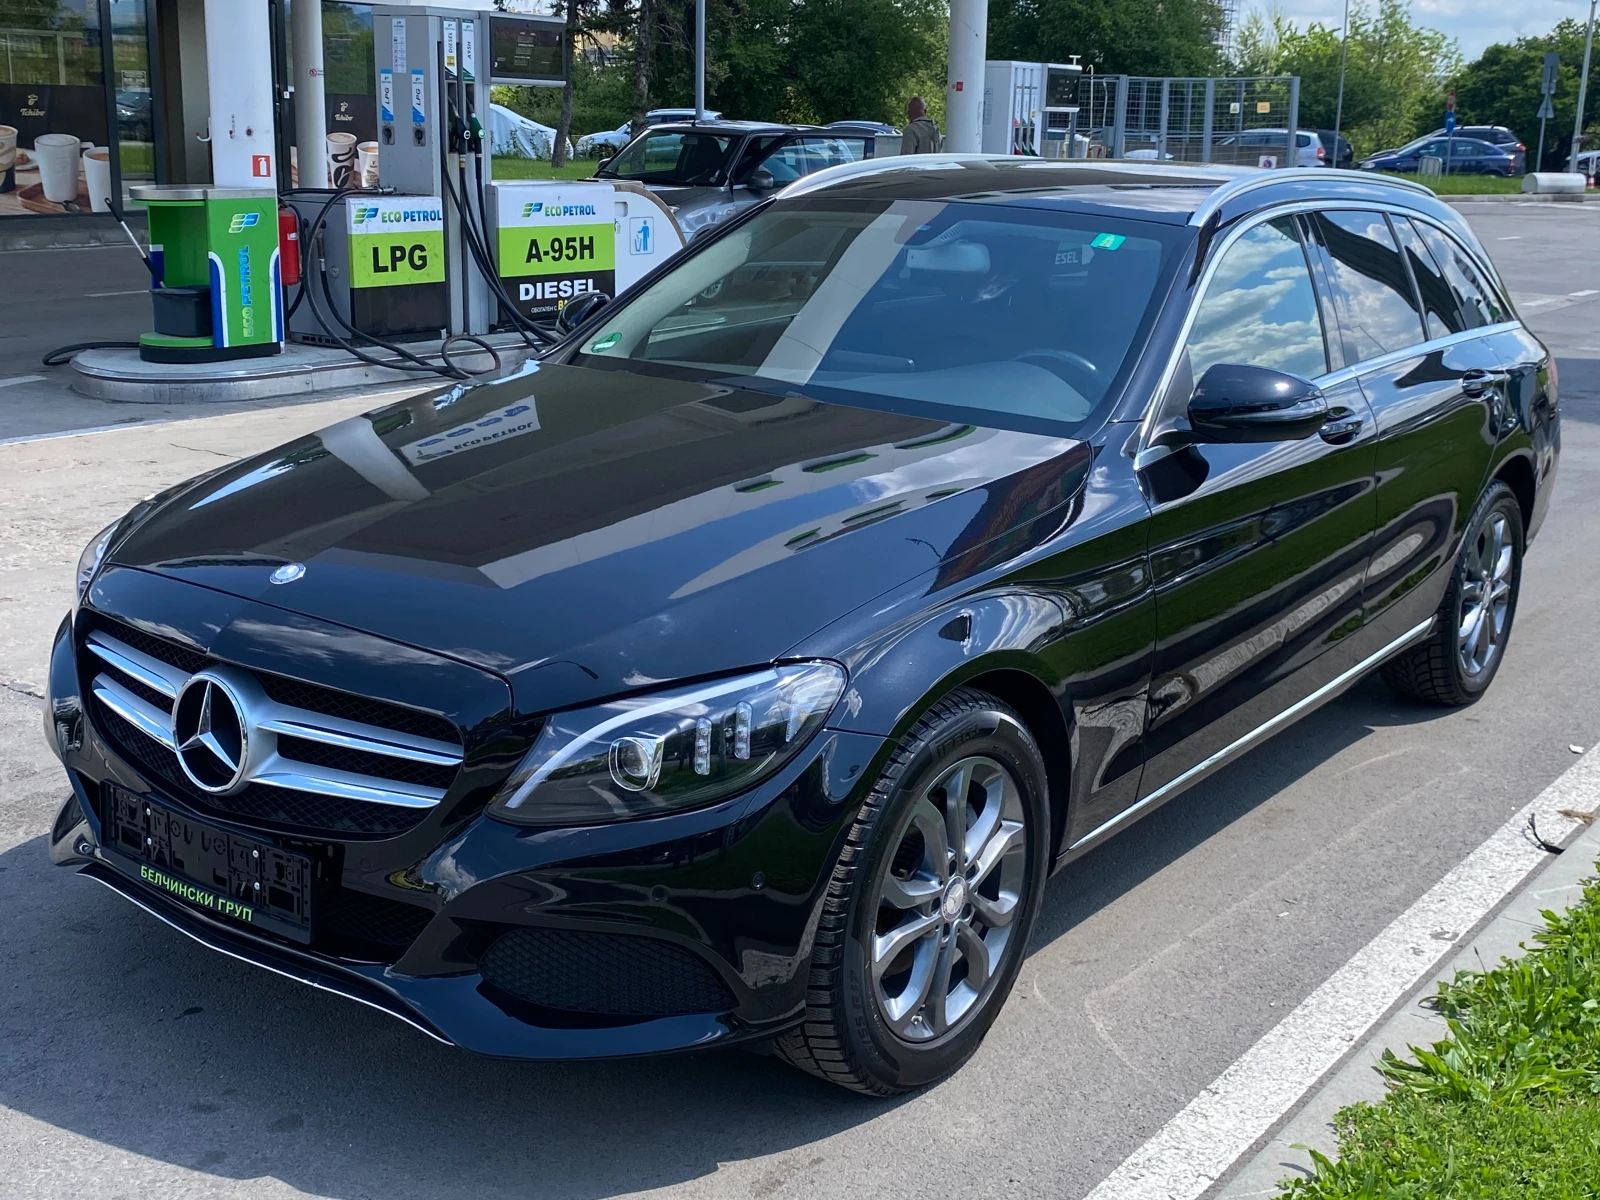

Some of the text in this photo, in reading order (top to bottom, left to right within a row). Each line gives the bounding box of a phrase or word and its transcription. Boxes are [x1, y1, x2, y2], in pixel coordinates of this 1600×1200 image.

[372, 244, 428, 273] LPG
[525, 235, 594, 263] A-95H
[519, 279, 600, 301] DIESEL
[140, 865, 252, 922] БЕЛЧИНСКИ ГРУП
